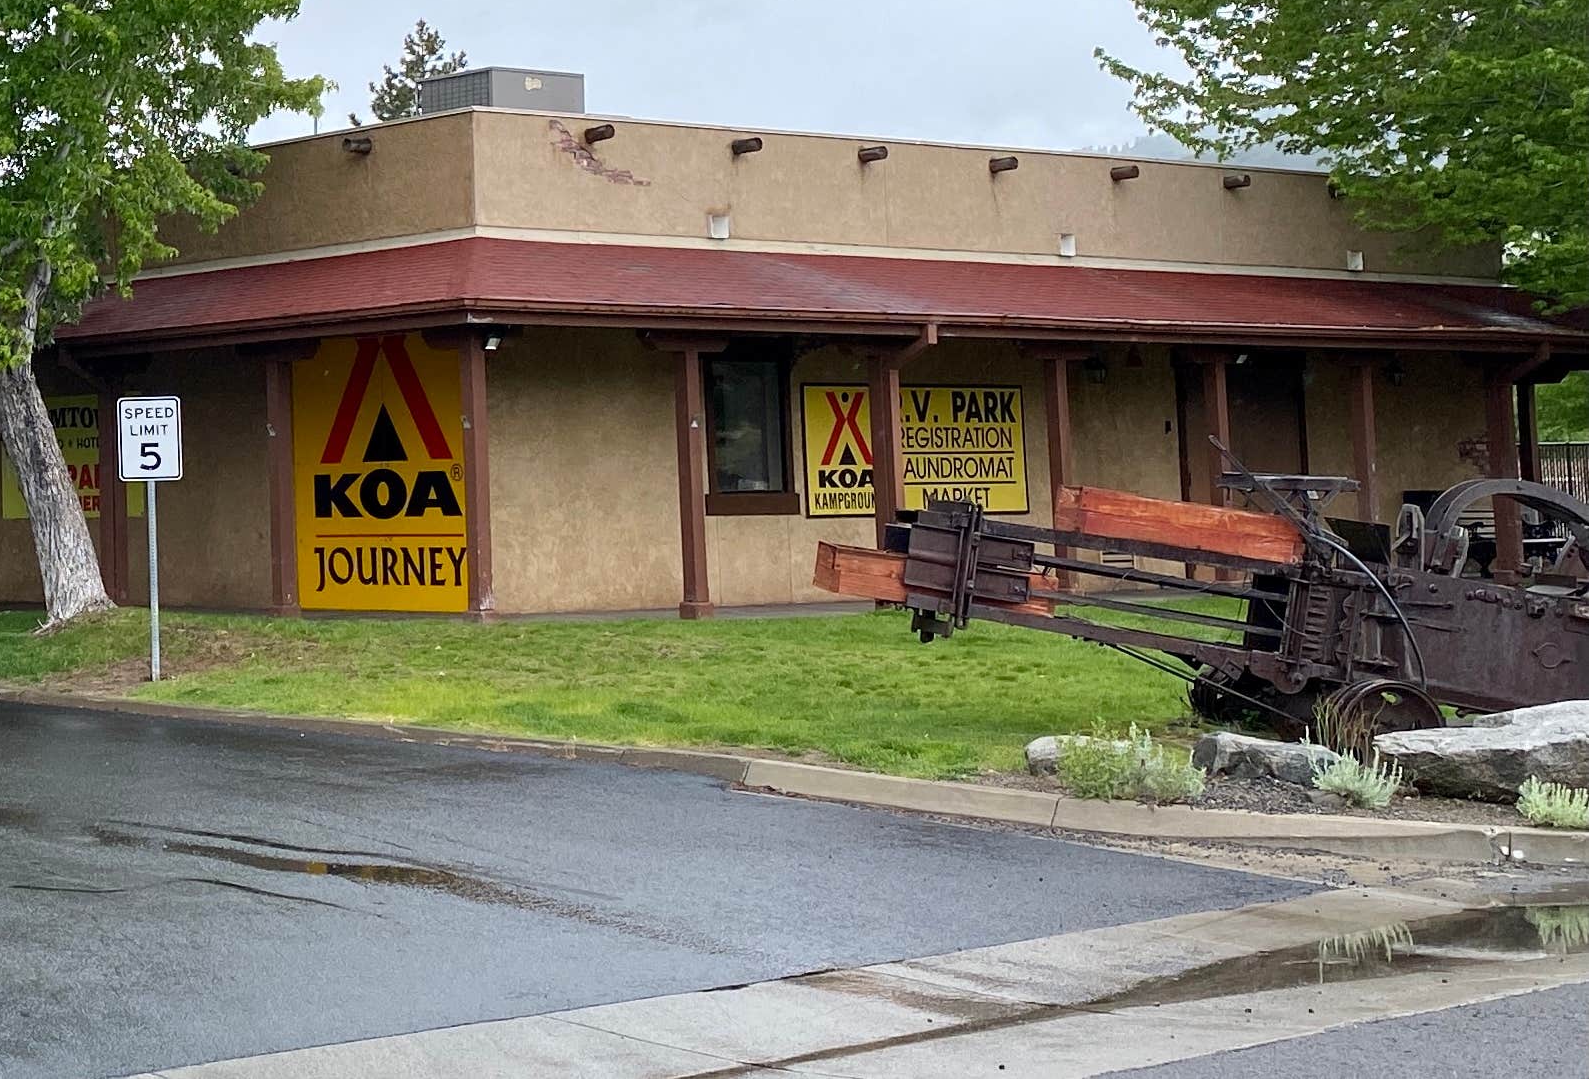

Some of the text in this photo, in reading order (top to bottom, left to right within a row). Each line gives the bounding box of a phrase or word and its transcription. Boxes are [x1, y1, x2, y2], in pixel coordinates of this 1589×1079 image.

[124, 407, 174, 419] SPEED
[899, 390, 1017, 423] .V. PARK
[130, 424, 169, 436] LIMIT
[76, 437, 99, 449] HOT
[139, 442, 162, 470] 5
[903, 456, 1015, 479] AUNDROMAT
[818, 468, 875, 489] KOA
[314, 468, 463, 519] KOA
[314, 546, 468, 592] JOURNEY
